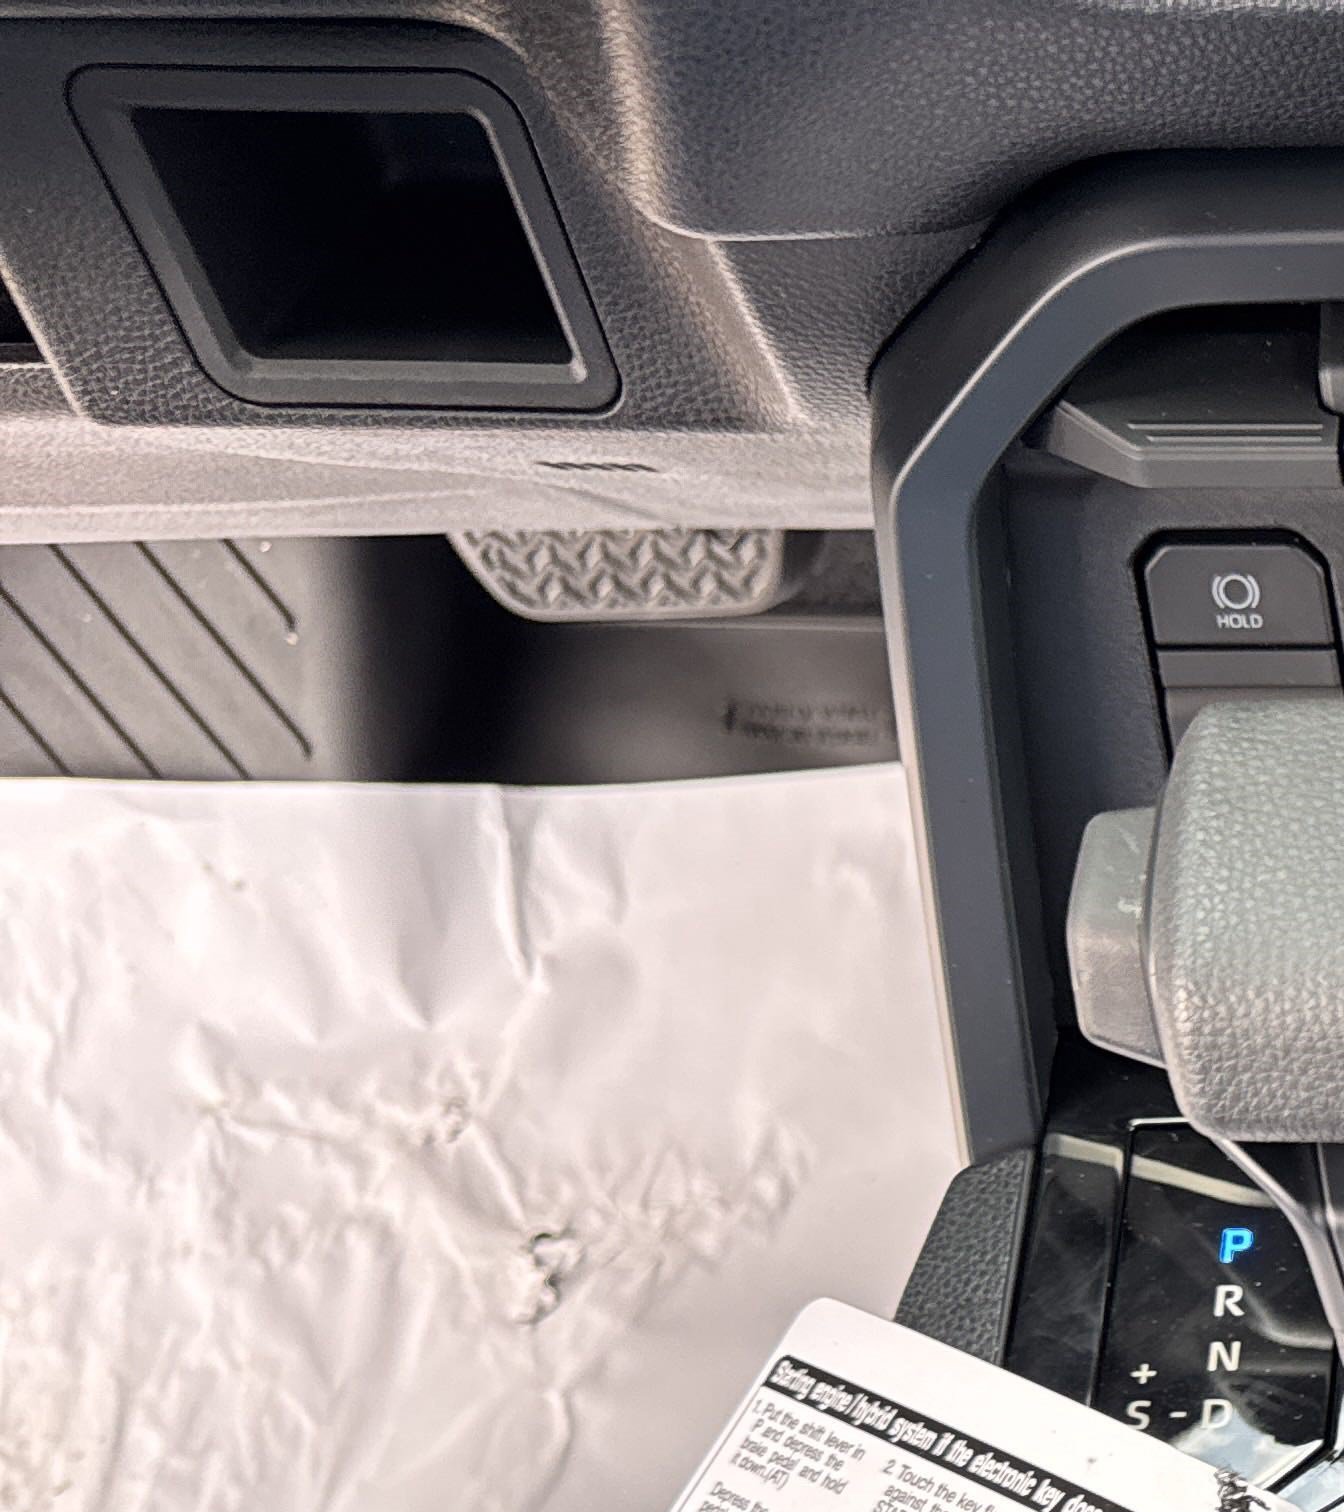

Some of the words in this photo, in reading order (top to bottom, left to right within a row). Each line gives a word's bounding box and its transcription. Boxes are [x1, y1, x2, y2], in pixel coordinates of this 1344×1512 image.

[1216, 613, 1263, 629] HOLD
[1220, 1227, 1253, 1264] P
[1213, 1285, 1245, 1317] R
[1207, 1340, 1241, 1372] N
[769, 1360, 817, 1400] Starting
[886, 1416, 938, 1452] system
[967, 1451, 1038, 1497] electronic
[1126, 1399, 1151, 1430] S
[1200, 1397, 1234, 1429] D
[896, 1463, 936, 1493] Touch
[883, 1484, 928, 1512] against
